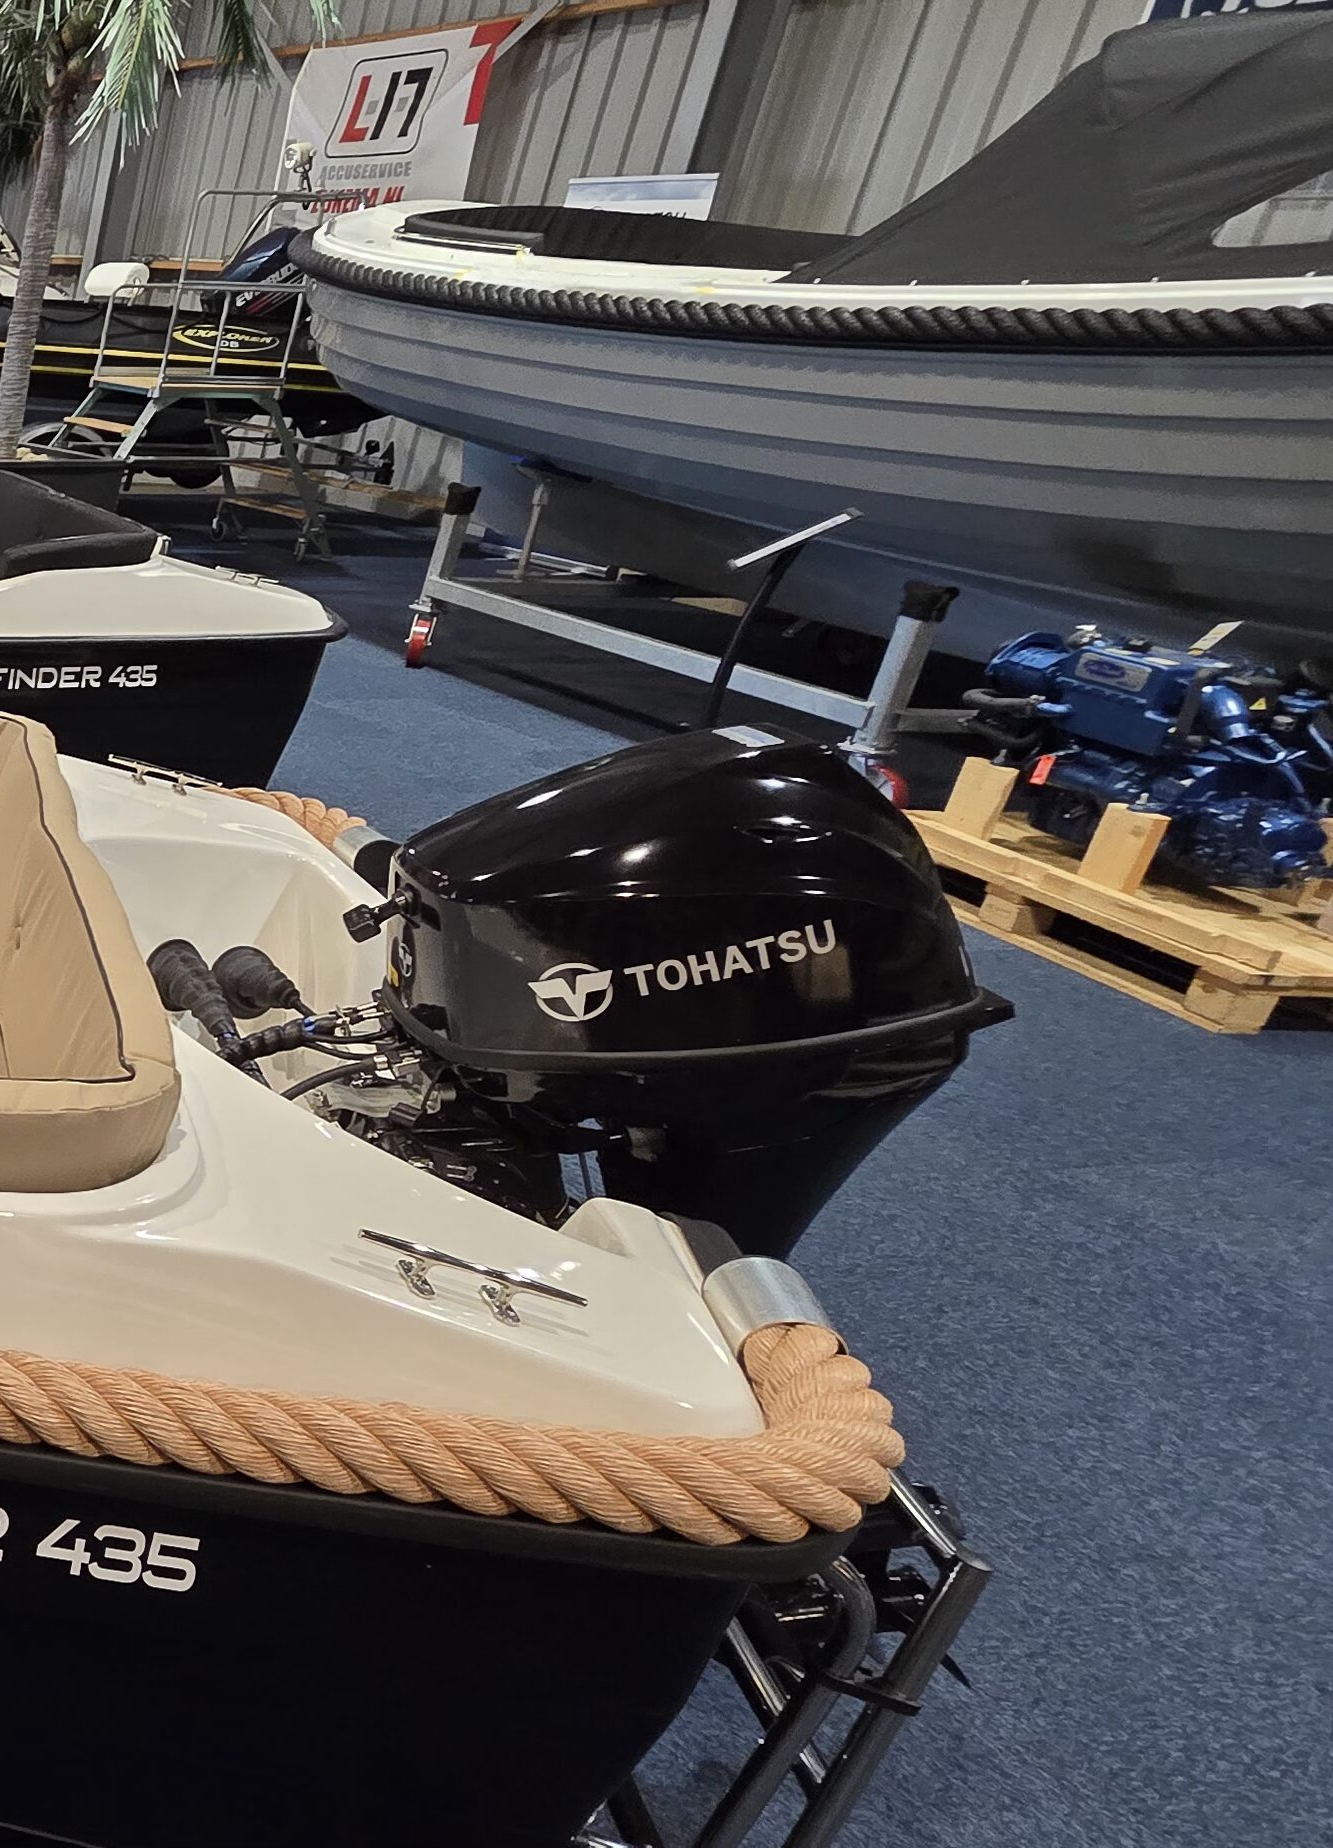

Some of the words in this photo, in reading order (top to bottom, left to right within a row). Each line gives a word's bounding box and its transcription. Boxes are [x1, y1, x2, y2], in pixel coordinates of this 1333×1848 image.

[318, 161, 413, 180] ACCUSERVICE
[108, 665, 158, 688] 435
[624, 919, 837, 997] TOHATSU
[37, 1518, 202, 1592] 435
